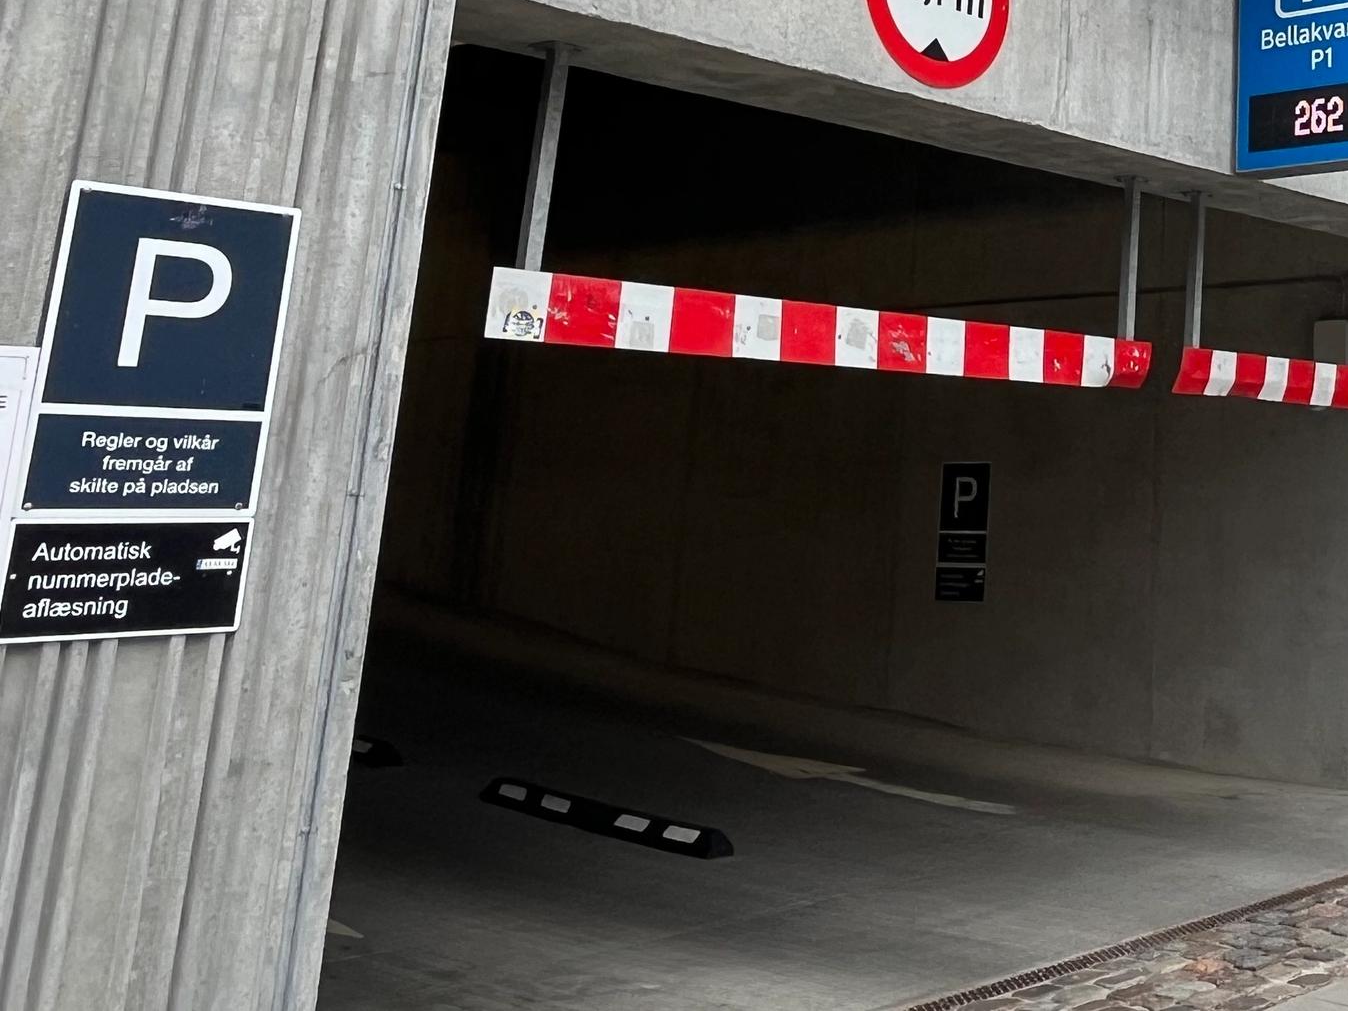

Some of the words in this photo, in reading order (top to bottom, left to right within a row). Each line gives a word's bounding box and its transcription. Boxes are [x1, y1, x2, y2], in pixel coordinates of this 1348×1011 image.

[1310, 47, 1334, 71] P1
[1293, 95, 1345, 137] 262
[117, 237, 233, 368] P
[81, 431, 142, 451] Regler
[145, 437, 169, 452] og
[173, 434, 220, 450] vilkår
[102, 455, 173, 474] fremgår
[175, 456, 195, 472] af
[69, 477, 119, 493] skilte
[122, 478, 146, 496] på
[150, 478, 220, 497] pladsen
[953, 476, 978, 519] P
[31, 541, 152, 562] Automatisk
[27, 567, 181, 591] nummerplade-
[22, 596, 129, 619] aflæsning
